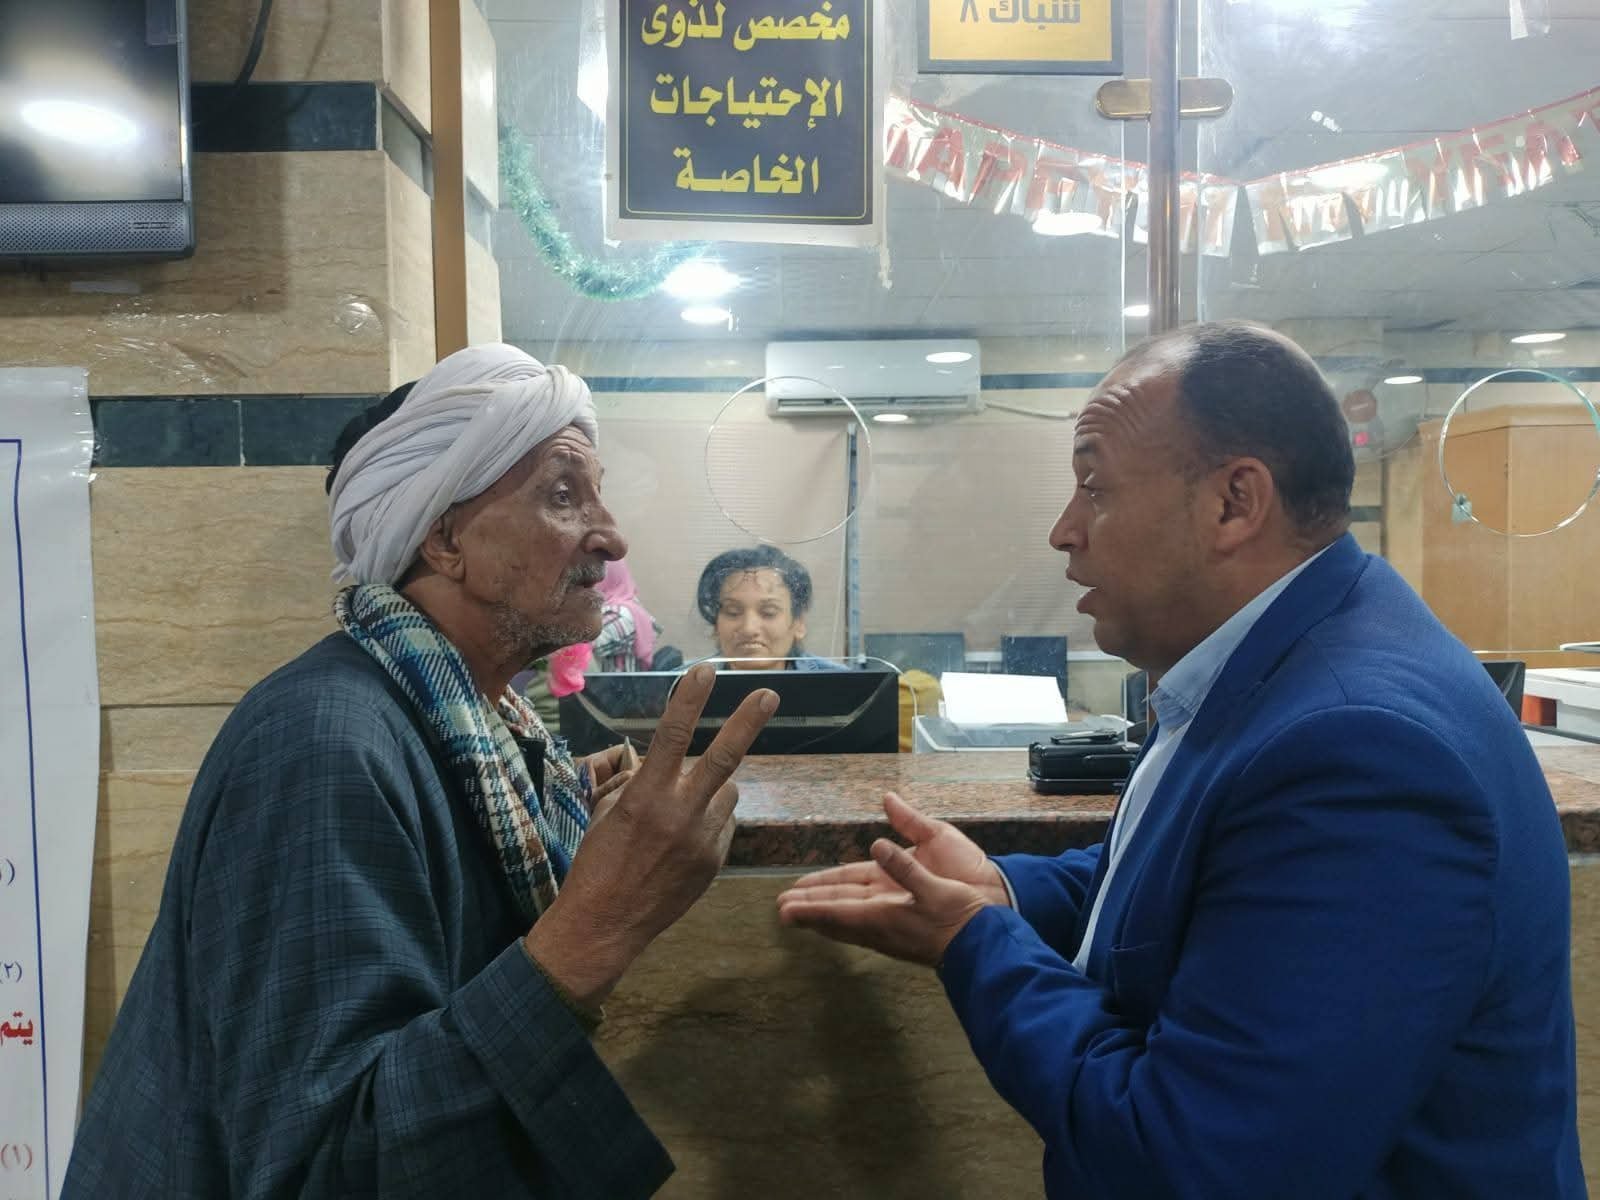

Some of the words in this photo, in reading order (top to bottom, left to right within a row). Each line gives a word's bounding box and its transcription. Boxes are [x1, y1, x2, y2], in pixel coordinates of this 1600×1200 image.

[733, 1, 850, 51] مخصص
[650, 73, 843, 131] الإحتياجات
[673, 147, 821, 195] الخاصة
